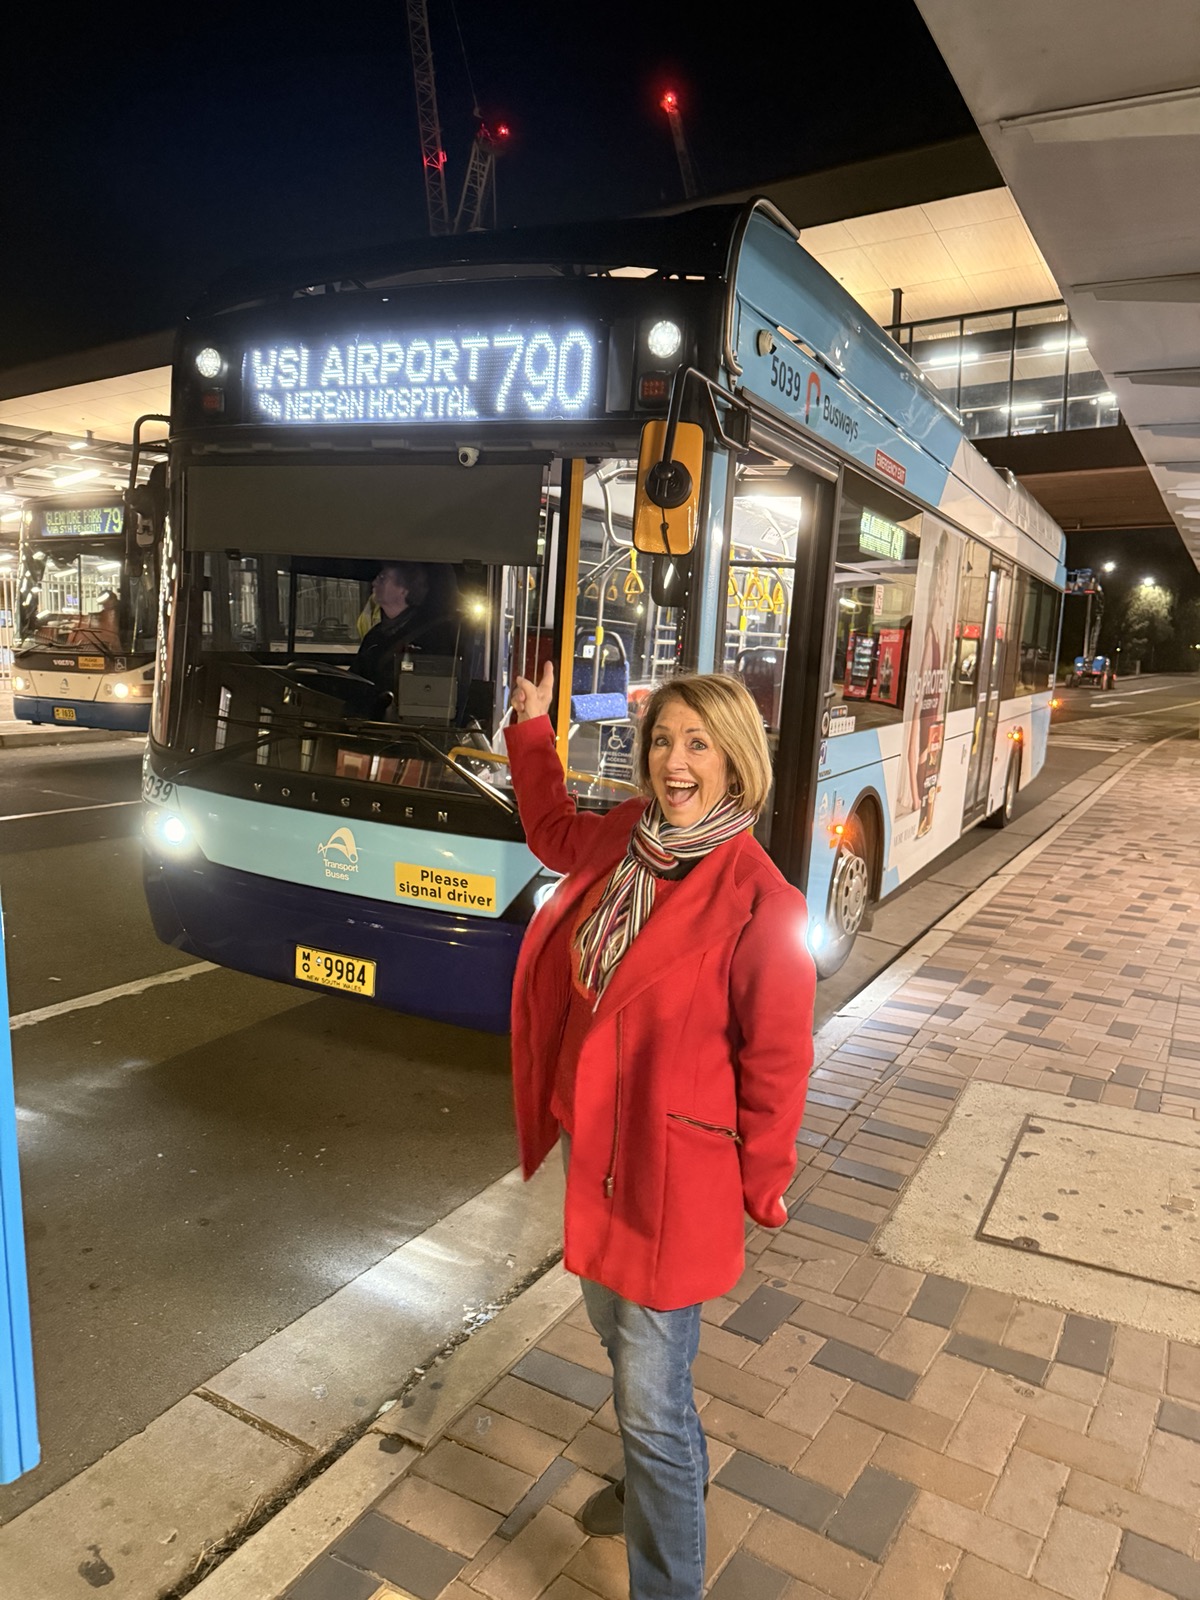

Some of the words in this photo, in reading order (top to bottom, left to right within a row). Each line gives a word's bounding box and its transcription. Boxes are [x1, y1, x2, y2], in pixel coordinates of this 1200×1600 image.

[252, 348, 308, 388] WSI
[320, 338, 489, 385] AIRPORT
[493, 331, 592, 412] 790
[770, 356, 801, 402] 5039
[285, 390, 364, 420] NEPEAN
[369, 384, 477, 418] HOSPITAL
[822, 394, 859, 442] Busways
[83, 509, 102, 524] PARK
[144, 771, 174, 803] 039
[253, 782, 448, 823] VOLGREN
[323, 858, 359, 873] Transport
[325, 869, 350, 881] Buses
[420, 869, 469, 889] Please
[399, 881, 442, 899] signal
[447, 888, 493, 907] driver
[321, 978, 341, 987] SOUTH
[343, 983, 362, 992] WALES
[324, 957, 365, 986] 9984
